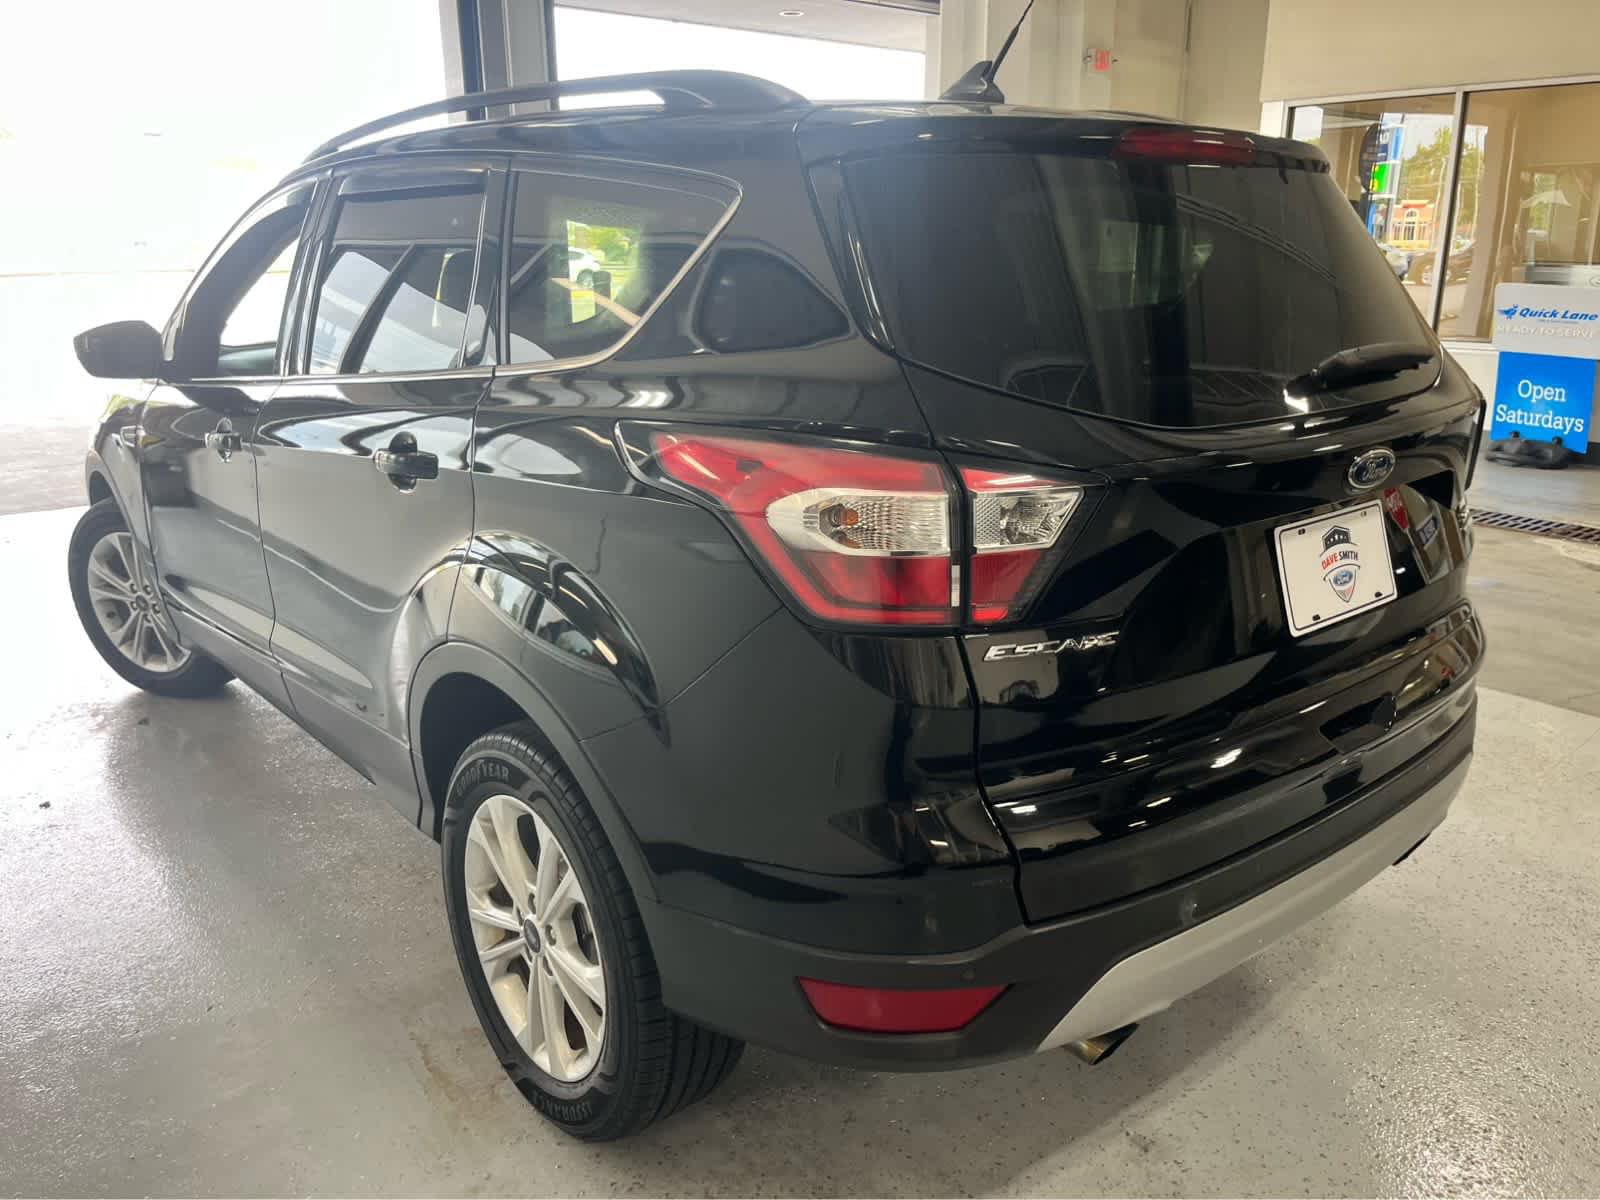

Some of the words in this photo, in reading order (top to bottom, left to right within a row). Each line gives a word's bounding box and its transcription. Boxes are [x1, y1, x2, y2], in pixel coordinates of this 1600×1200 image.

[1519, 307, 1559, 320] Quick
[1561, 309, 1599, 322] Lane
[1517, 379, 1567, 403] Open
[1496, 404, 1585, 435] Saturdays
[1321, 552, 1339, 570] DAVE
[1338, 550, 1359, 561] SMITH
[983, 631, 1120, 662] ESCAPE
